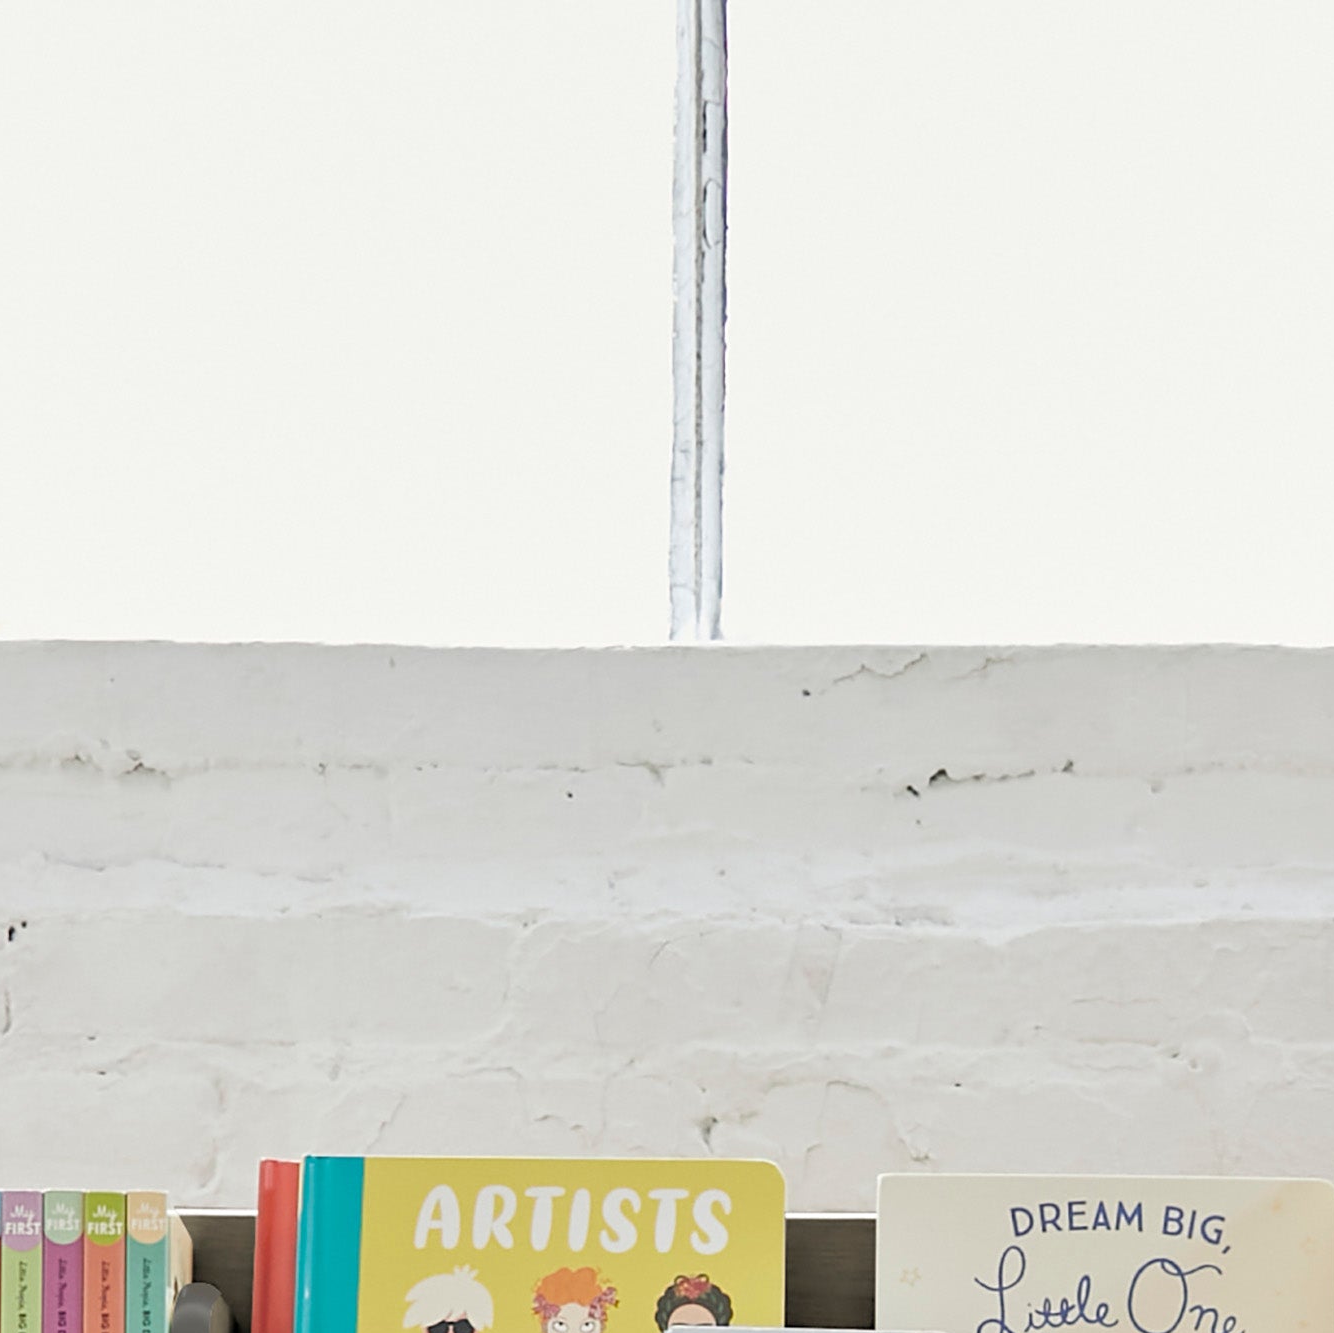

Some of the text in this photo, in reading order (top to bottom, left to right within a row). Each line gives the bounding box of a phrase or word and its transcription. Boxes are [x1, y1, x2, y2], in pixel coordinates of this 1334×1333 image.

[10, 1204, 35, 1223] My
[93, 1204, 117, 1223] My
[414, 1184, 731, 1255] ARTISTS
[5, 1222, 41, 1235] FIRST
[87, 1222, 123, 1235] FIRST
[1011, 1201, 1231, 1254] DREAM BIG,
[19, 1313, 27, 1329] BIG
[101, 1313, 109, 1329] BIG
